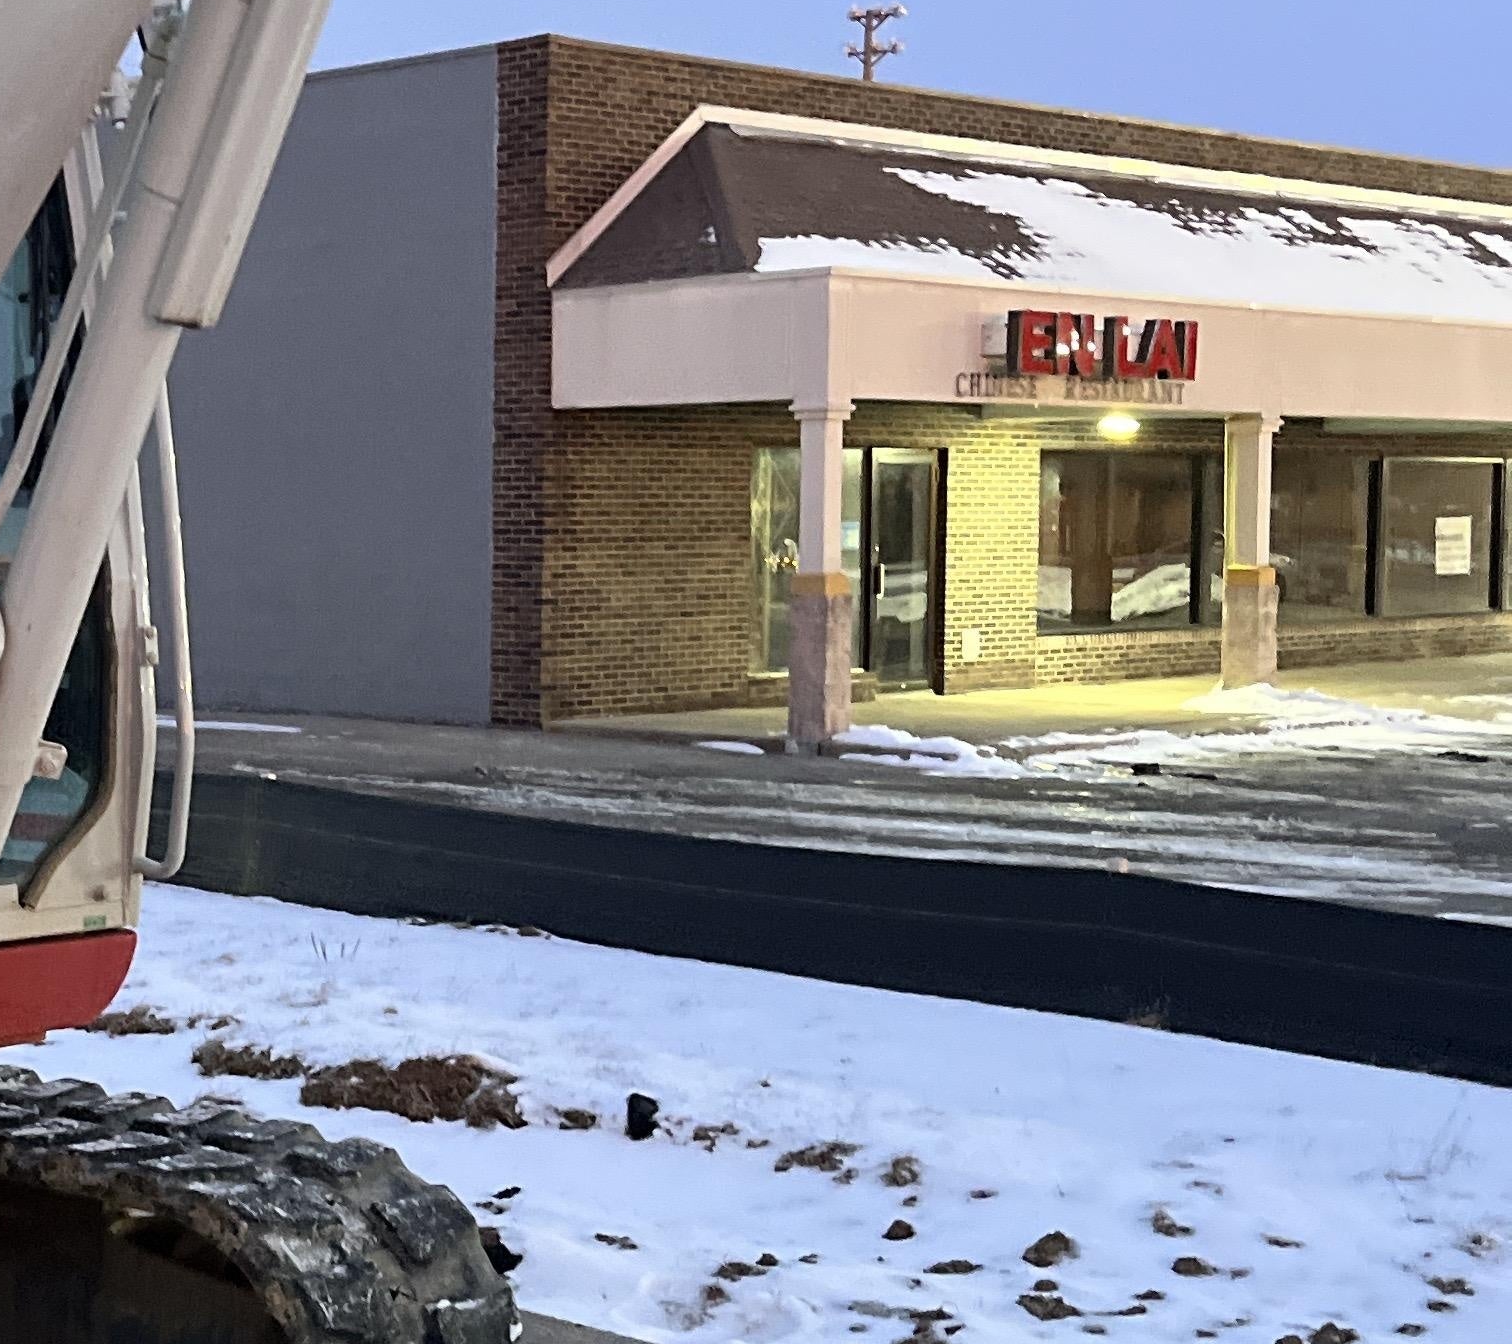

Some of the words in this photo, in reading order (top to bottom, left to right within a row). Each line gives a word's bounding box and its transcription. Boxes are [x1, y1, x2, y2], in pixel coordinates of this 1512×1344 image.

[1009, 310, 1095, 376] EN
[1106, 315, 1199, 381] LAI
[955, 371, 1037, 399] CHINESE
[1064, 375, 1185, 405] RESTAURANT
